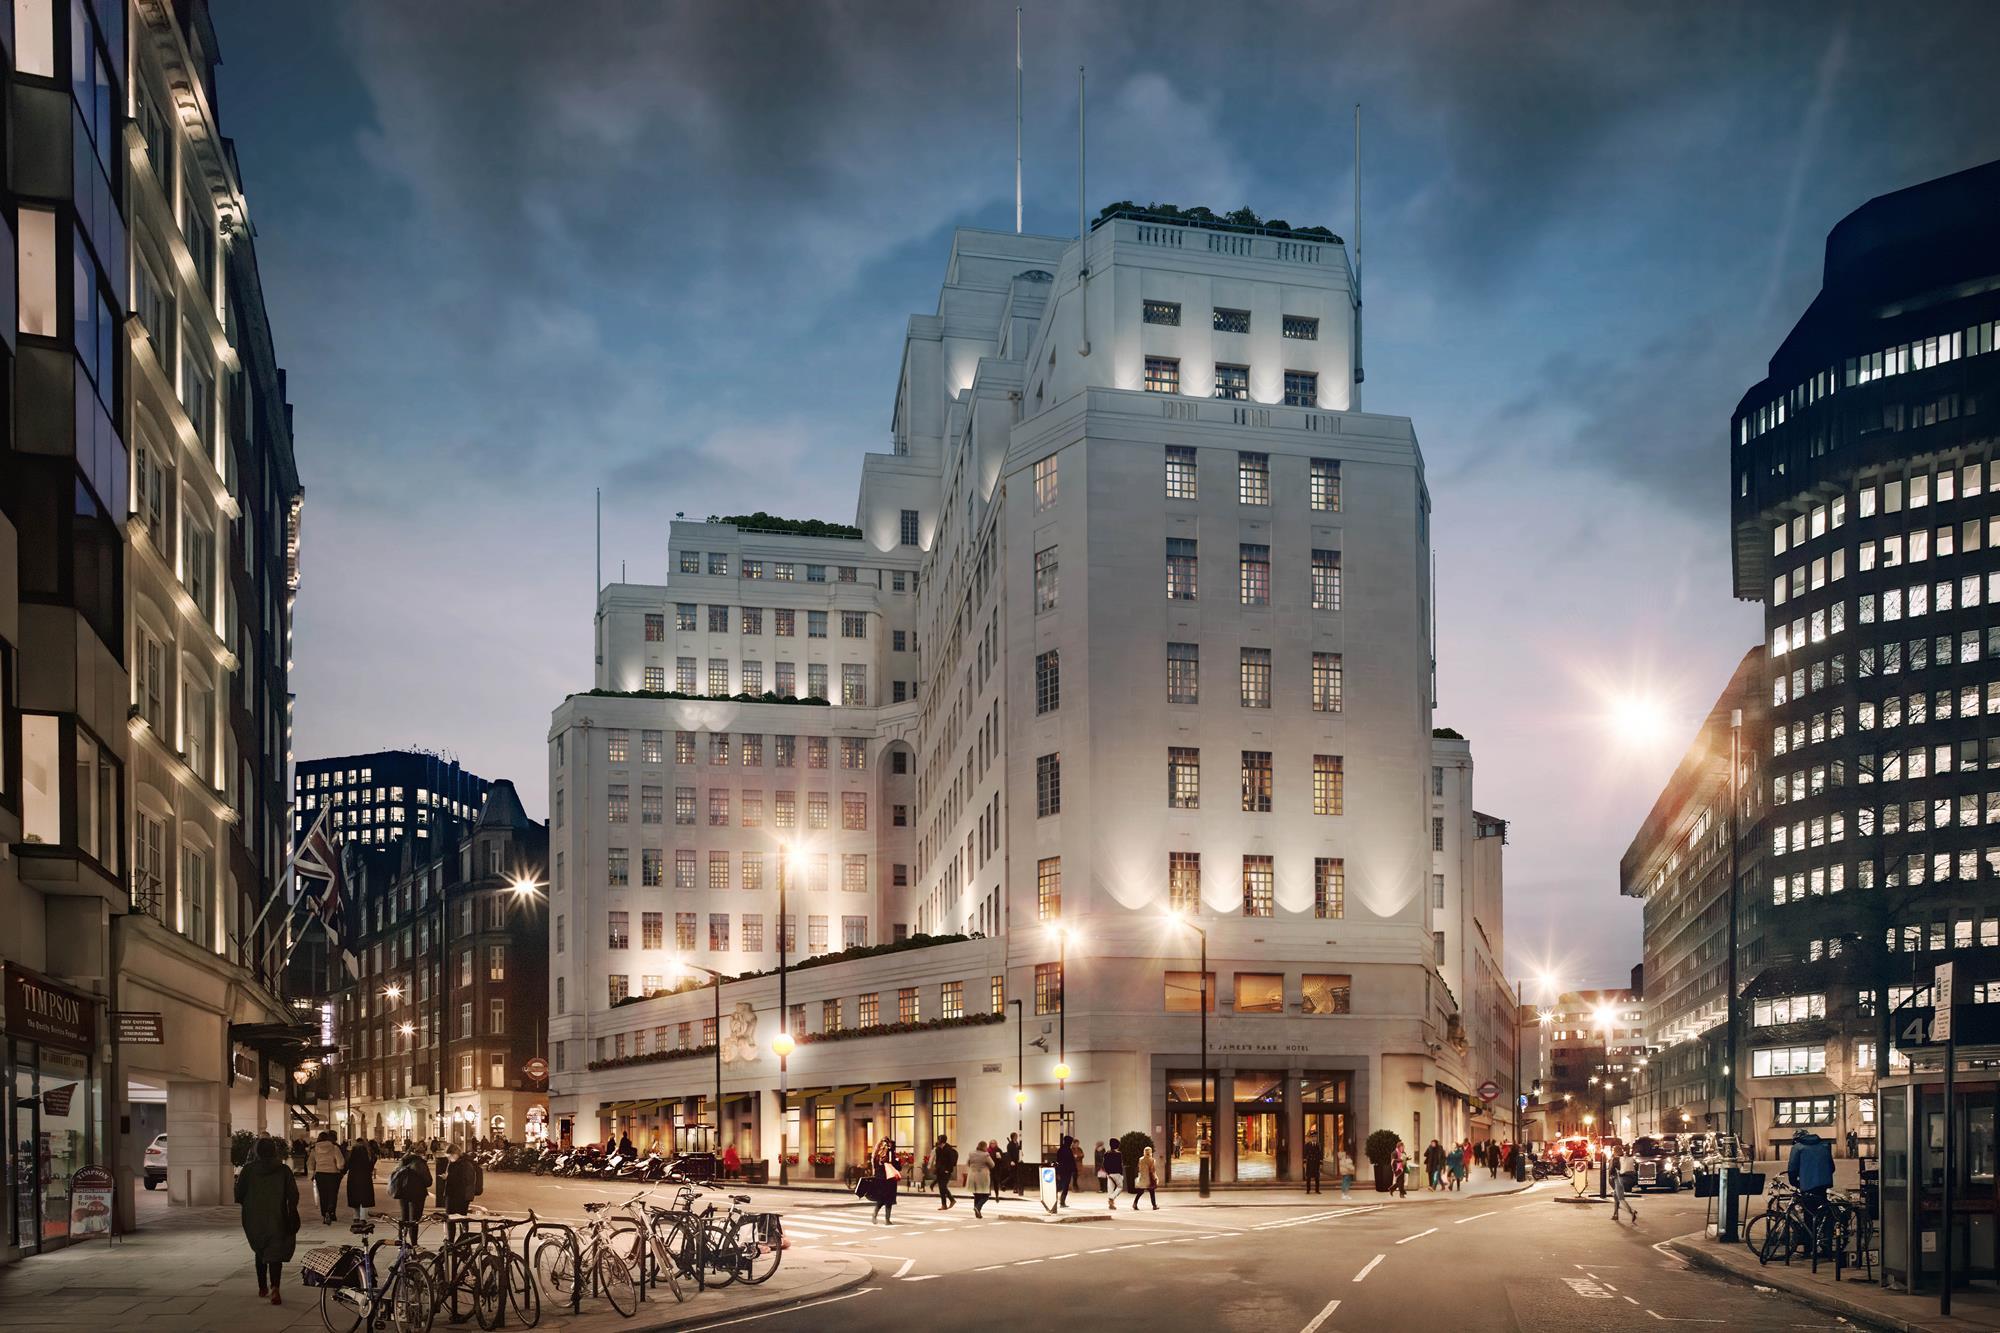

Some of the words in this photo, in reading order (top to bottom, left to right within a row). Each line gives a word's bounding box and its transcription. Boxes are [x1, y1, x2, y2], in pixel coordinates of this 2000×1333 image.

[22, 983, 80, 1025] TIMPSON
[1902, 1017, 1936, 1044] 4
[77, 1170, 109, 1180] TIMPSON
[1849, 1252, 1857, 1267] P
